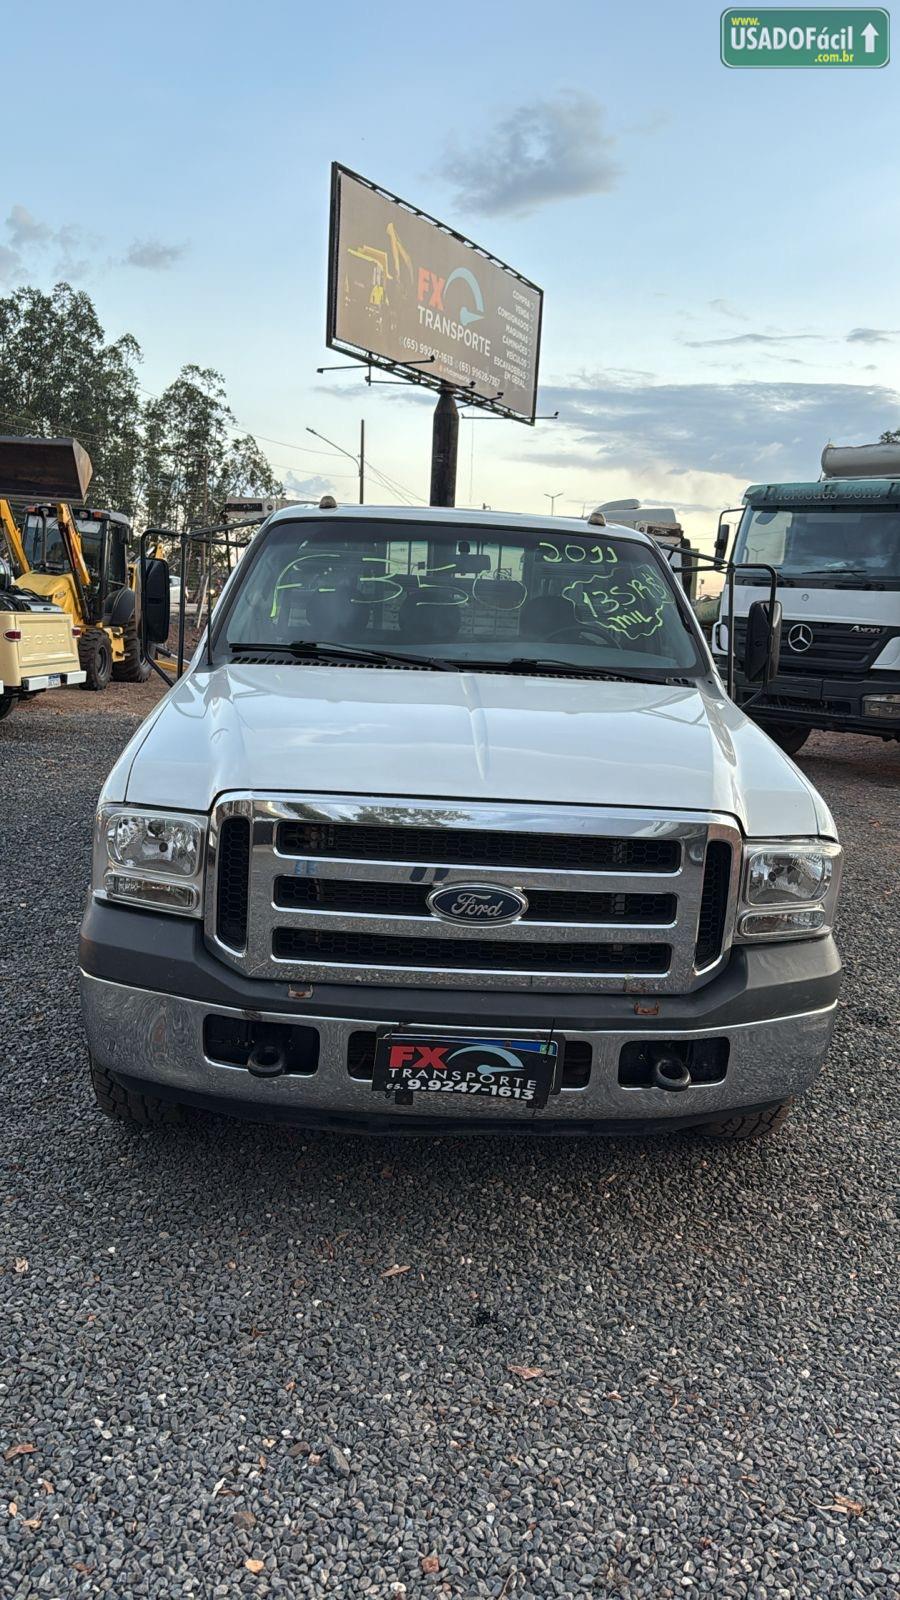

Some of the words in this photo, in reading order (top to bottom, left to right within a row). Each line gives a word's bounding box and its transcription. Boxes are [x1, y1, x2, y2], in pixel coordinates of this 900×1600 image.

[417, 266, 447, 311] FX
[417, 304, 491, 357] TRANSPORTE
[403, 336, 418, 352] (65)
[539, 542, 618, 563] 2011
[451, 892, 504, 917] Ford
[388, 1045, 449, 1070] FX
[388, 1068, 537, 1090] TRANSPORTE
[407, 1079, 535, 1100] 9.9247-1613
